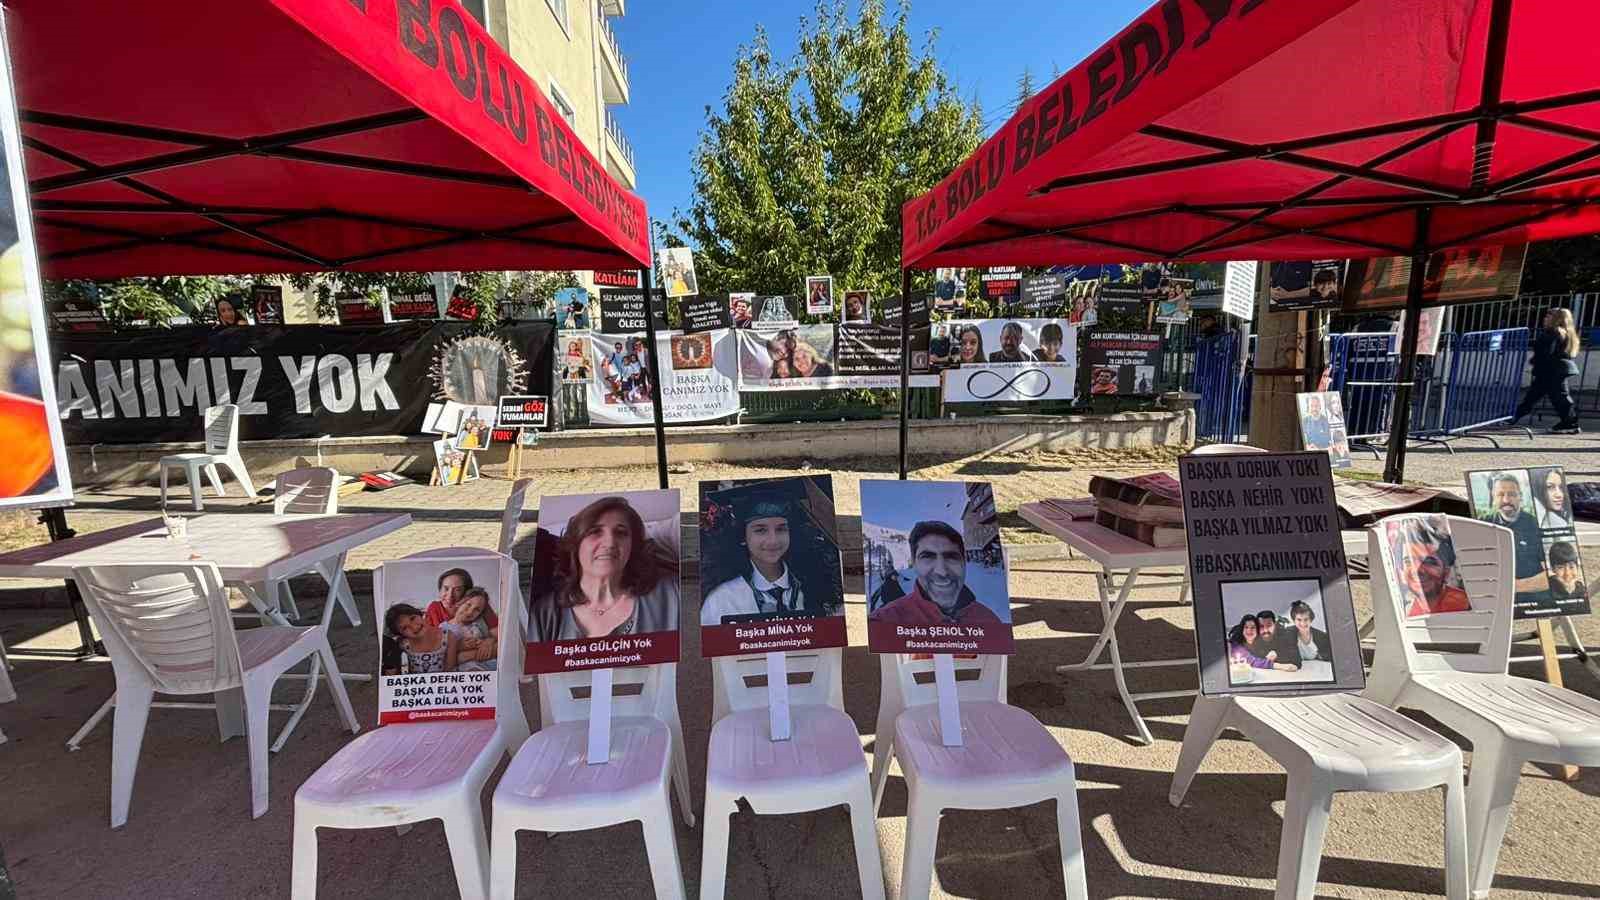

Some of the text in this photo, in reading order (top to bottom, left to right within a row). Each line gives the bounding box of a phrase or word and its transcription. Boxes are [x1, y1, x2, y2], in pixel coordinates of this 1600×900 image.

[396, 0, 528, 145] BOLU
[914, 199, 941, 243] T.C.
[947, 137, 1006, 219] BOLU
[594, 272, 637, 286] KATLİAM
[677, 374, 711, 384] BAŞKA
[57, 353, 399, 420] ANIMIZ YOK
[708, 384, 729, 394] YOK
[524, 400, 544, 412] GÖZ
[502, 413, 544, 421] YUMANLAR
[493, 430, 512, 440] YOK!
[1187, 458, 1319, 483] BAŞKA DORUK YOK!
[1191, 484, 1324, 511] BAŞKA NEHİR YOK!
[1193, 515, 1328, 540] BAŞKA YILMAZ YOK!
[1195, 549, 1341, 576] #BAŞKACANIMIZYOK
[735, 624, 814, 639] Başka MİNA Yok
[896, 626, 985, 638] Başka ŞENOL Yok
[554, 638, 652, 655] Başka GÜLÇİN Yok
[740, 638, 811, 650] #baskacanimizyok
[905, 640, 978, 650] #baskacanimizyok
[564, 654, 642, 667] #baskacanimizyok
[386, 673, 491, 688] BAŞKA DEFNE YOK
[394, 685, 484, 698] BAŞKA ELA YOK
[392, 696, 485, 708] BAŞKA DİLA YOK
[408, 711, 470, 720] @baskacanimizyok
